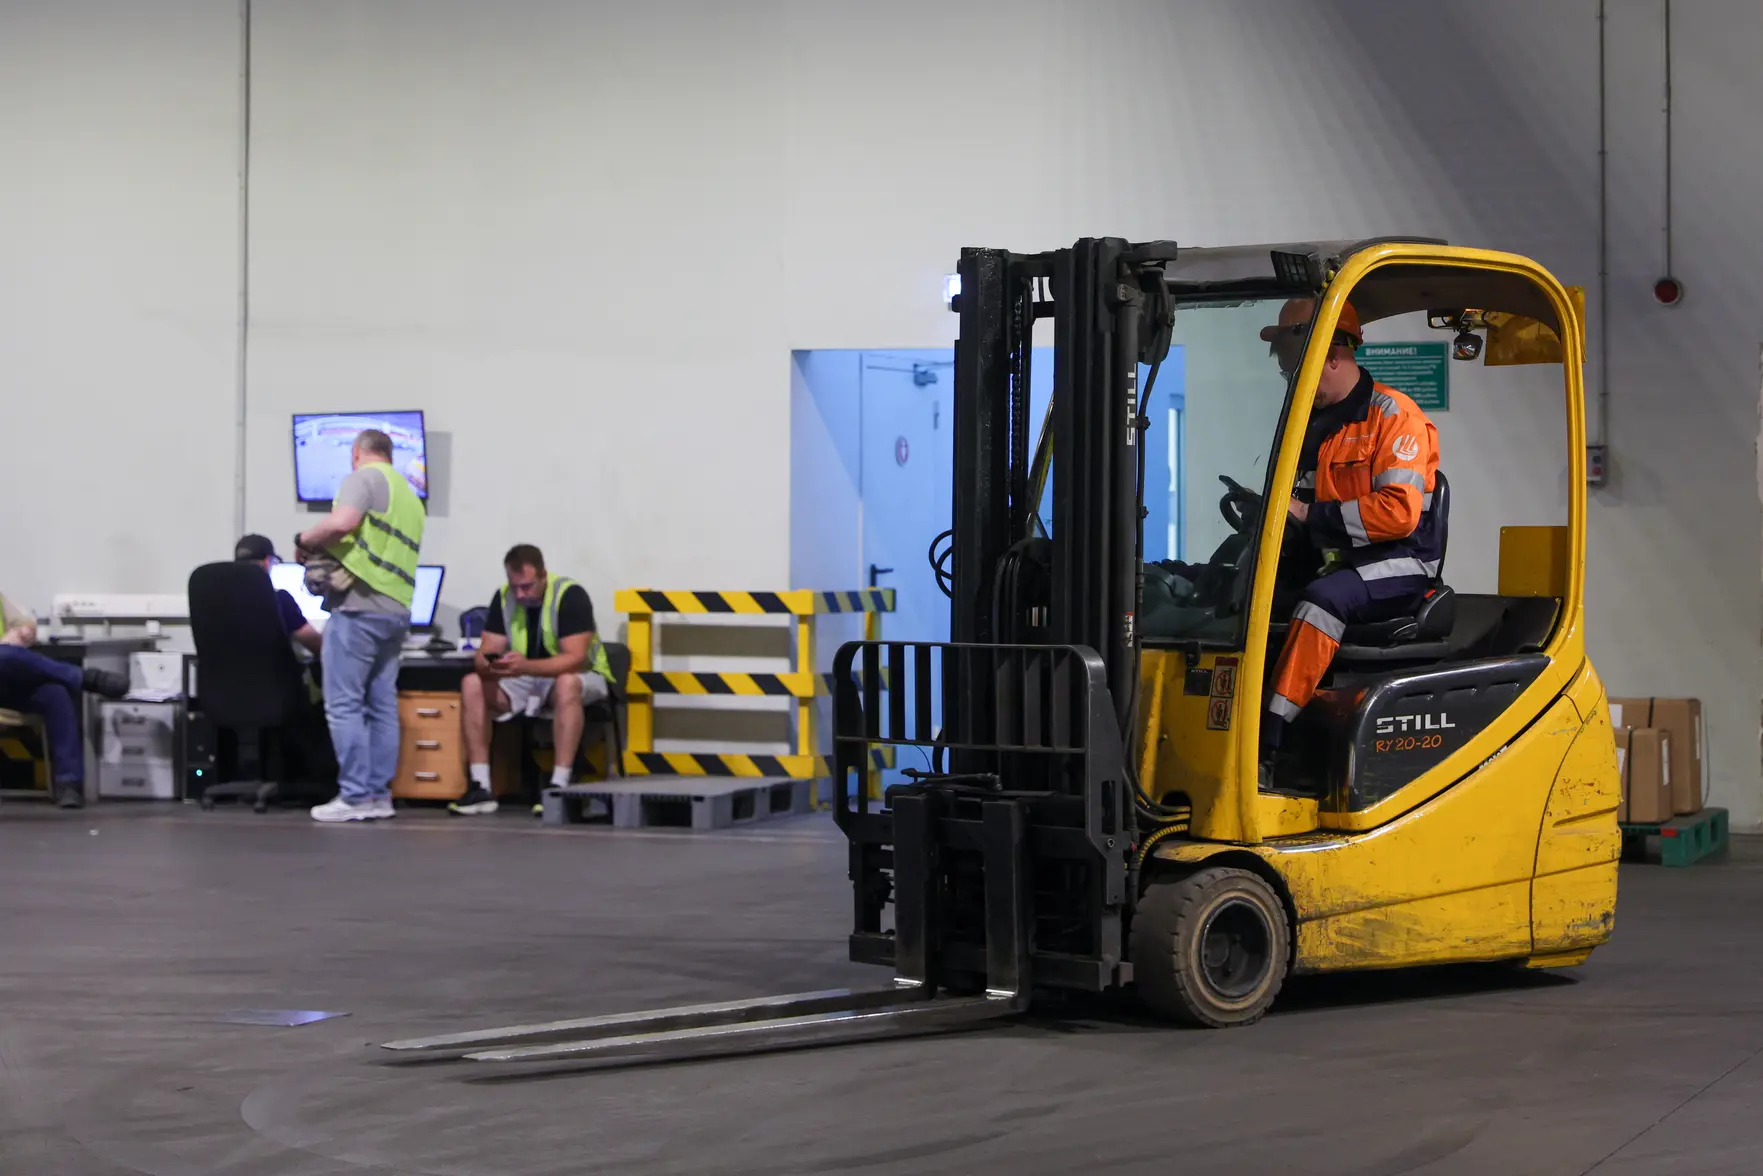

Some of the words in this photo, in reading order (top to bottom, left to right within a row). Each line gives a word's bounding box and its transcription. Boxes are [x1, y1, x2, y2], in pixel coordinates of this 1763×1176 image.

[1365, 347, 1417, 356] ВНИМАНИЕ!
[1126, 362, 1136, 446] STILL
[1376, 712, 1456, 734] STILL
[1395, 734, 1442, 751] 20-20
